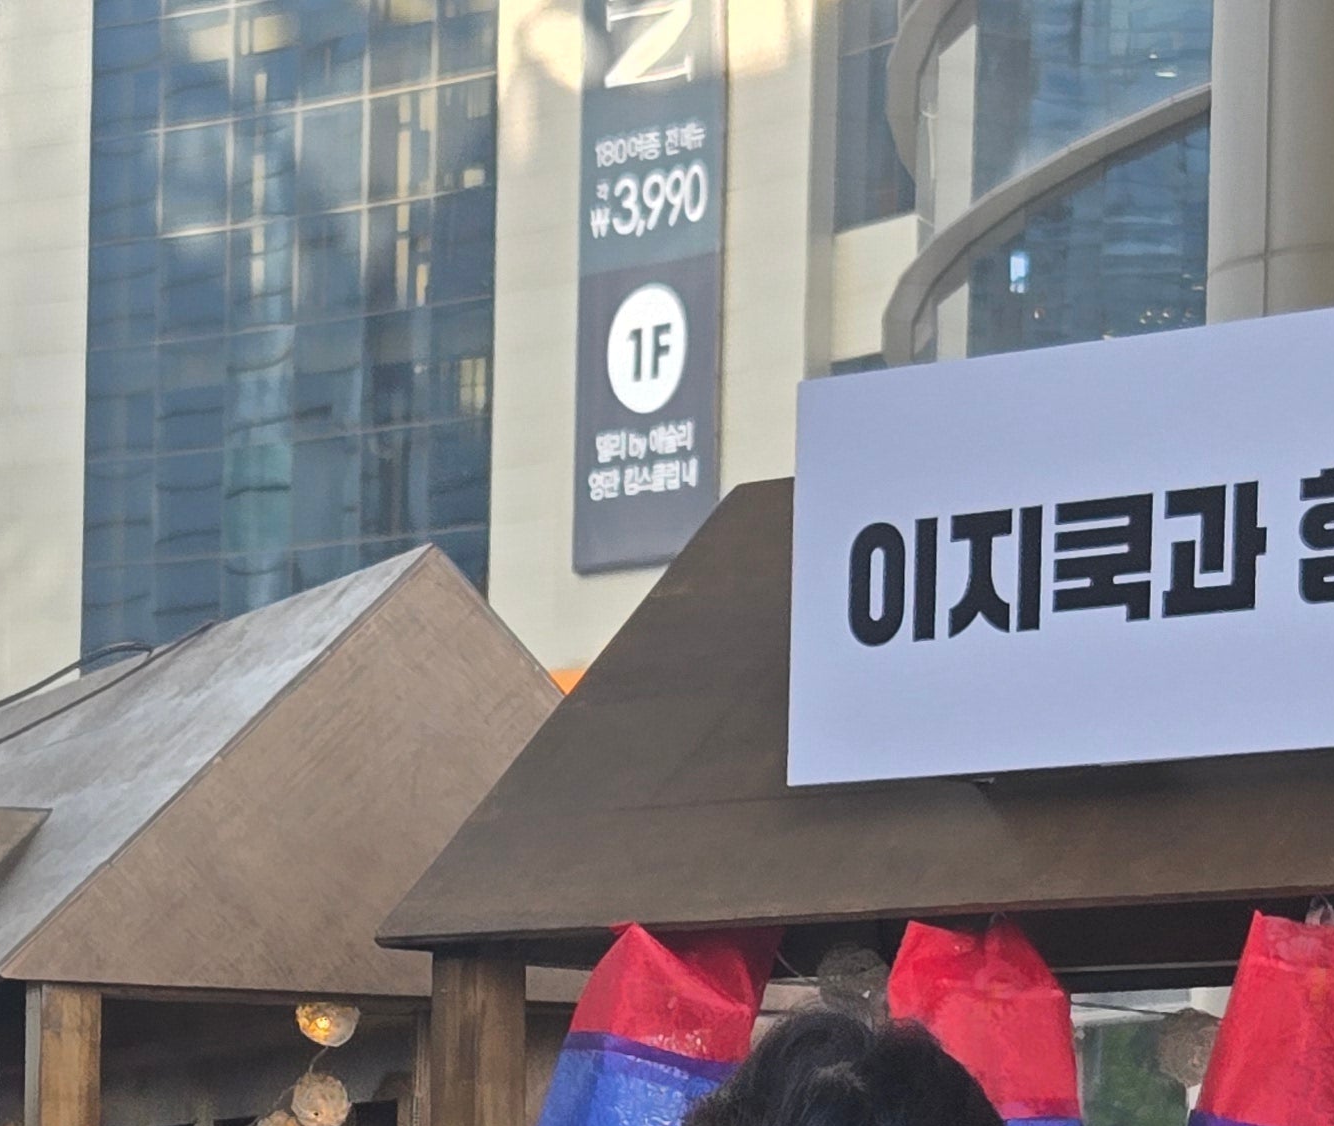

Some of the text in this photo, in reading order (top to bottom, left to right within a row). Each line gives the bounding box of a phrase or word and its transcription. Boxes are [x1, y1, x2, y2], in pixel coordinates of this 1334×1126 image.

[627, 322, 672, 383] 1F
[628, 433, 647, 459] by
[846, 479, 1268, 647] 이지쿡과
